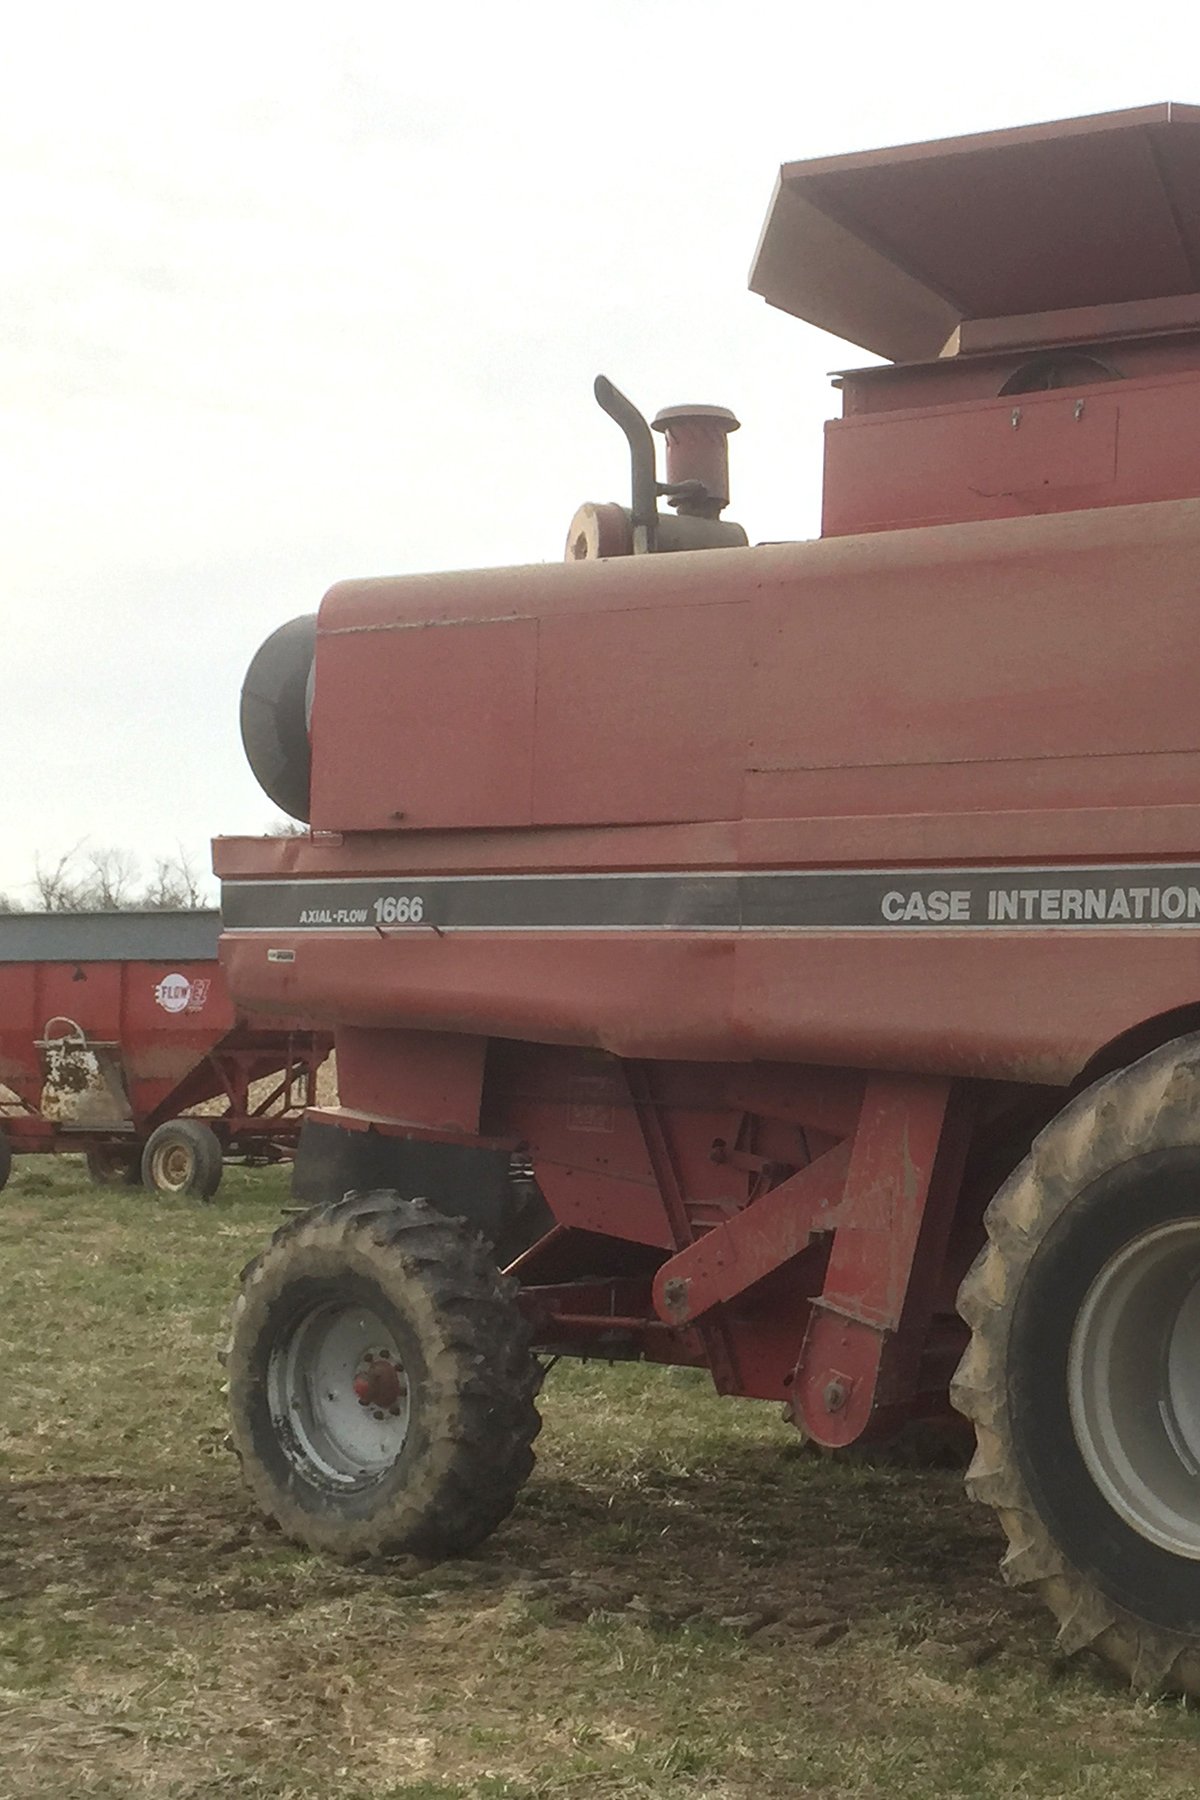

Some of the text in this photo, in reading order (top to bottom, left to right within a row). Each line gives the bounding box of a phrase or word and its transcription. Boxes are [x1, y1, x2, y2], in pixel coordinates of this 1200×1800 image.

[373, 896, 424, 922] 1666
[881, 891, 970, 921] CASE
[161, 985, 190, 999] FLOW
